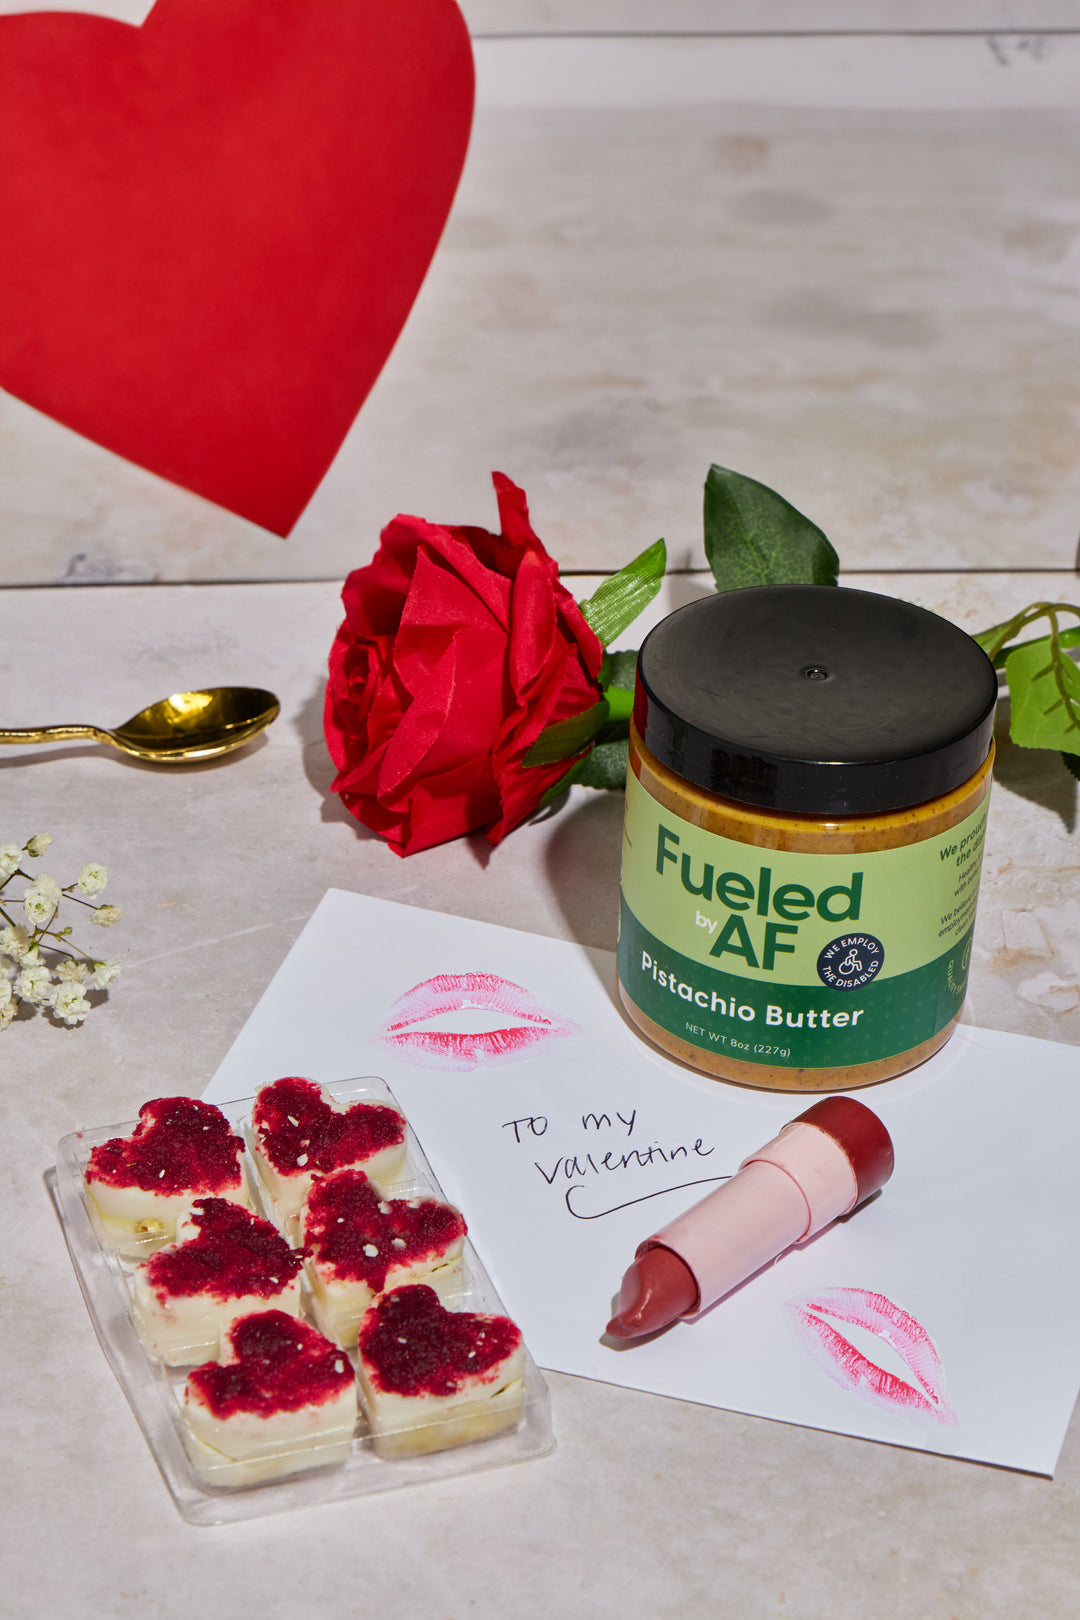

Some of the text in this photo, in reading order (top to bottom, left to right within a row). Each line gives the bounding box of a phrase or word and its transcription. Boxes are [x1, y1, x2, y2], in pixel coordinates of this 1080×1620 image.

[656, 823, 864, 922] Fueled
[695, 910, 798, 971] by AF
[824, 937, 879, 959] WE EMPLOY
[641, 951, 864, 1029] Pistachio Butter
[822, 960, 879, 988] THE DISABLED
[685, 1022, 791, 1058] NET WT 8oz (227g)
[582, 1109, 636, 1136] my
